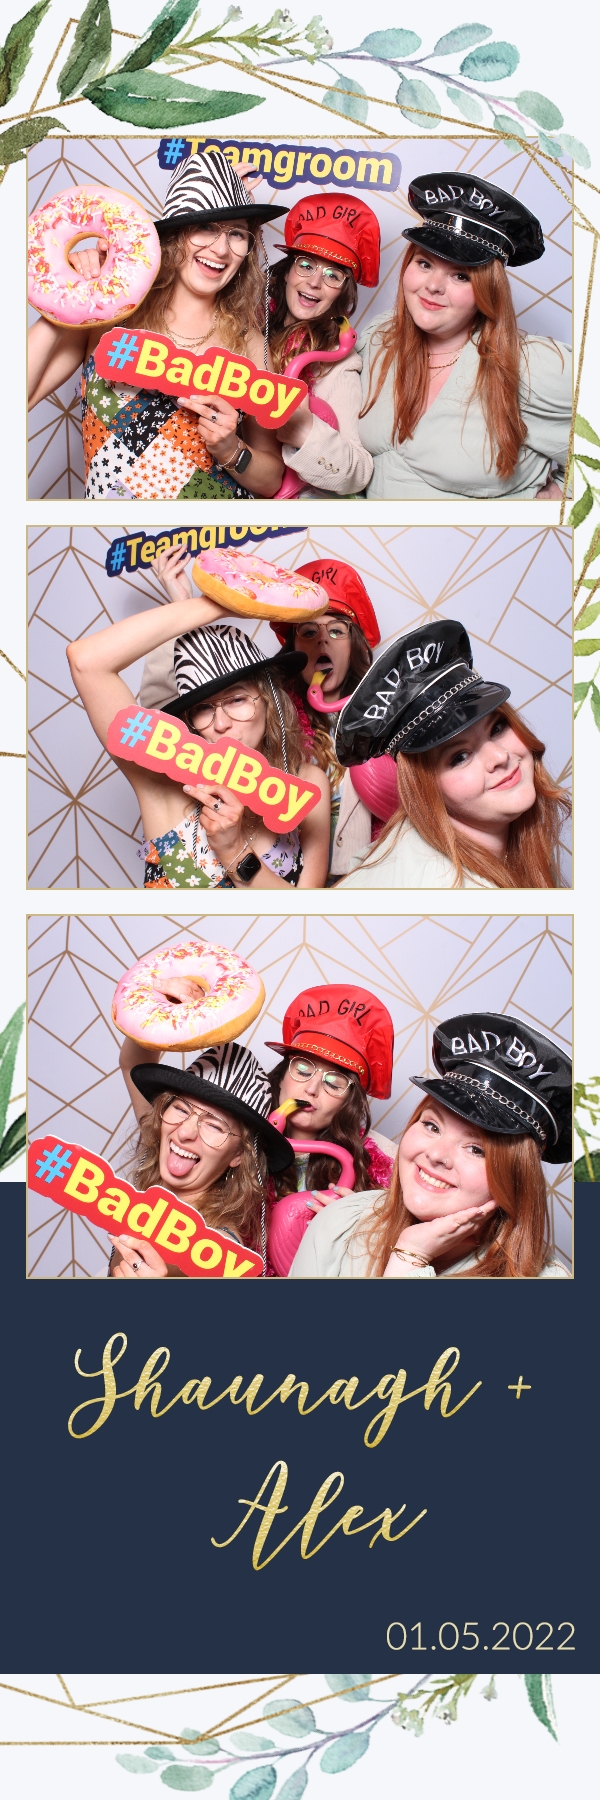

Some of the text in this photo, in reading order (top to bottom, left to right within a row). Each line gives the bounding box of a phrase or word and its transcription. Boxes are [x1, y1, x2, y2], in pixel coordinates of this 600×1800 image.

[332, 205, 362, 229] GIRL
[424, 185, 506, 217] BAD BOY
[106, 333, 302, 419] #BadBoy
[311, 567, 338, 586] GIRL
[363, 640, 445, 721] BAD BOY
[120, 711, 314, 823] #BadBoy
[337, 998, 371, 1027] GIRL
[451, 1030, 553, 1080] BAD BOY
